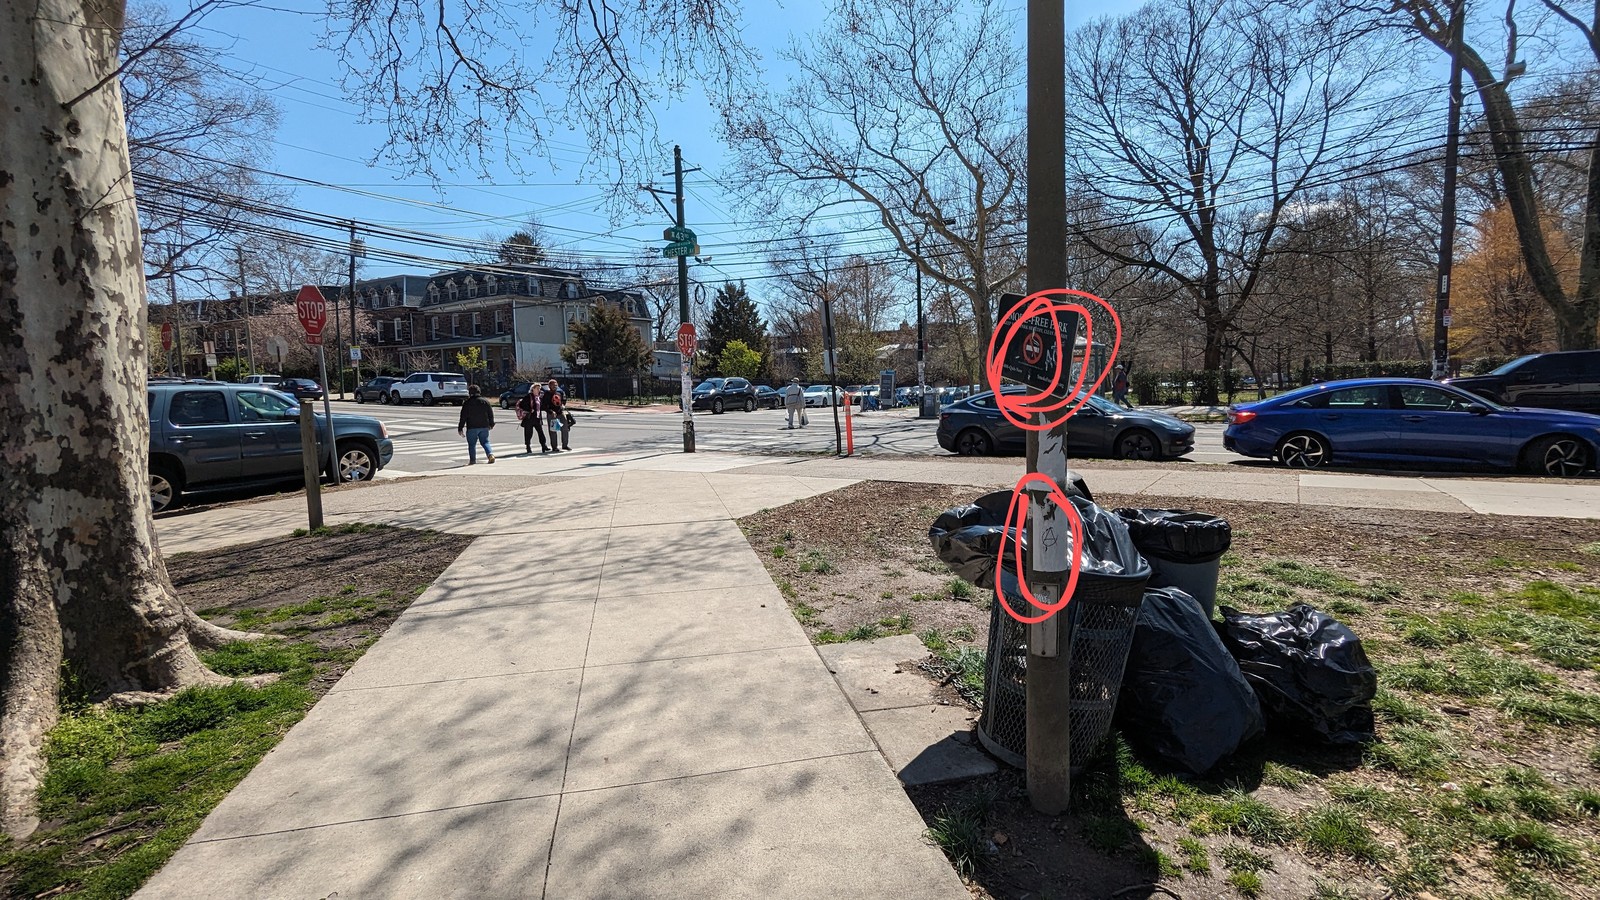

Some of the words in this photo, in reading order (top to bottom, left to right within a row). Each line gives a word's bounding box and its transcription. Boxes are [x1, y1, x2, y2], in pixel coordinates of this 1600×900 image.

[663, 246, 688, 258] CHESTER
[298, 301, 324, 320] STOP
[1049, 317, 1069, 334] PRK
